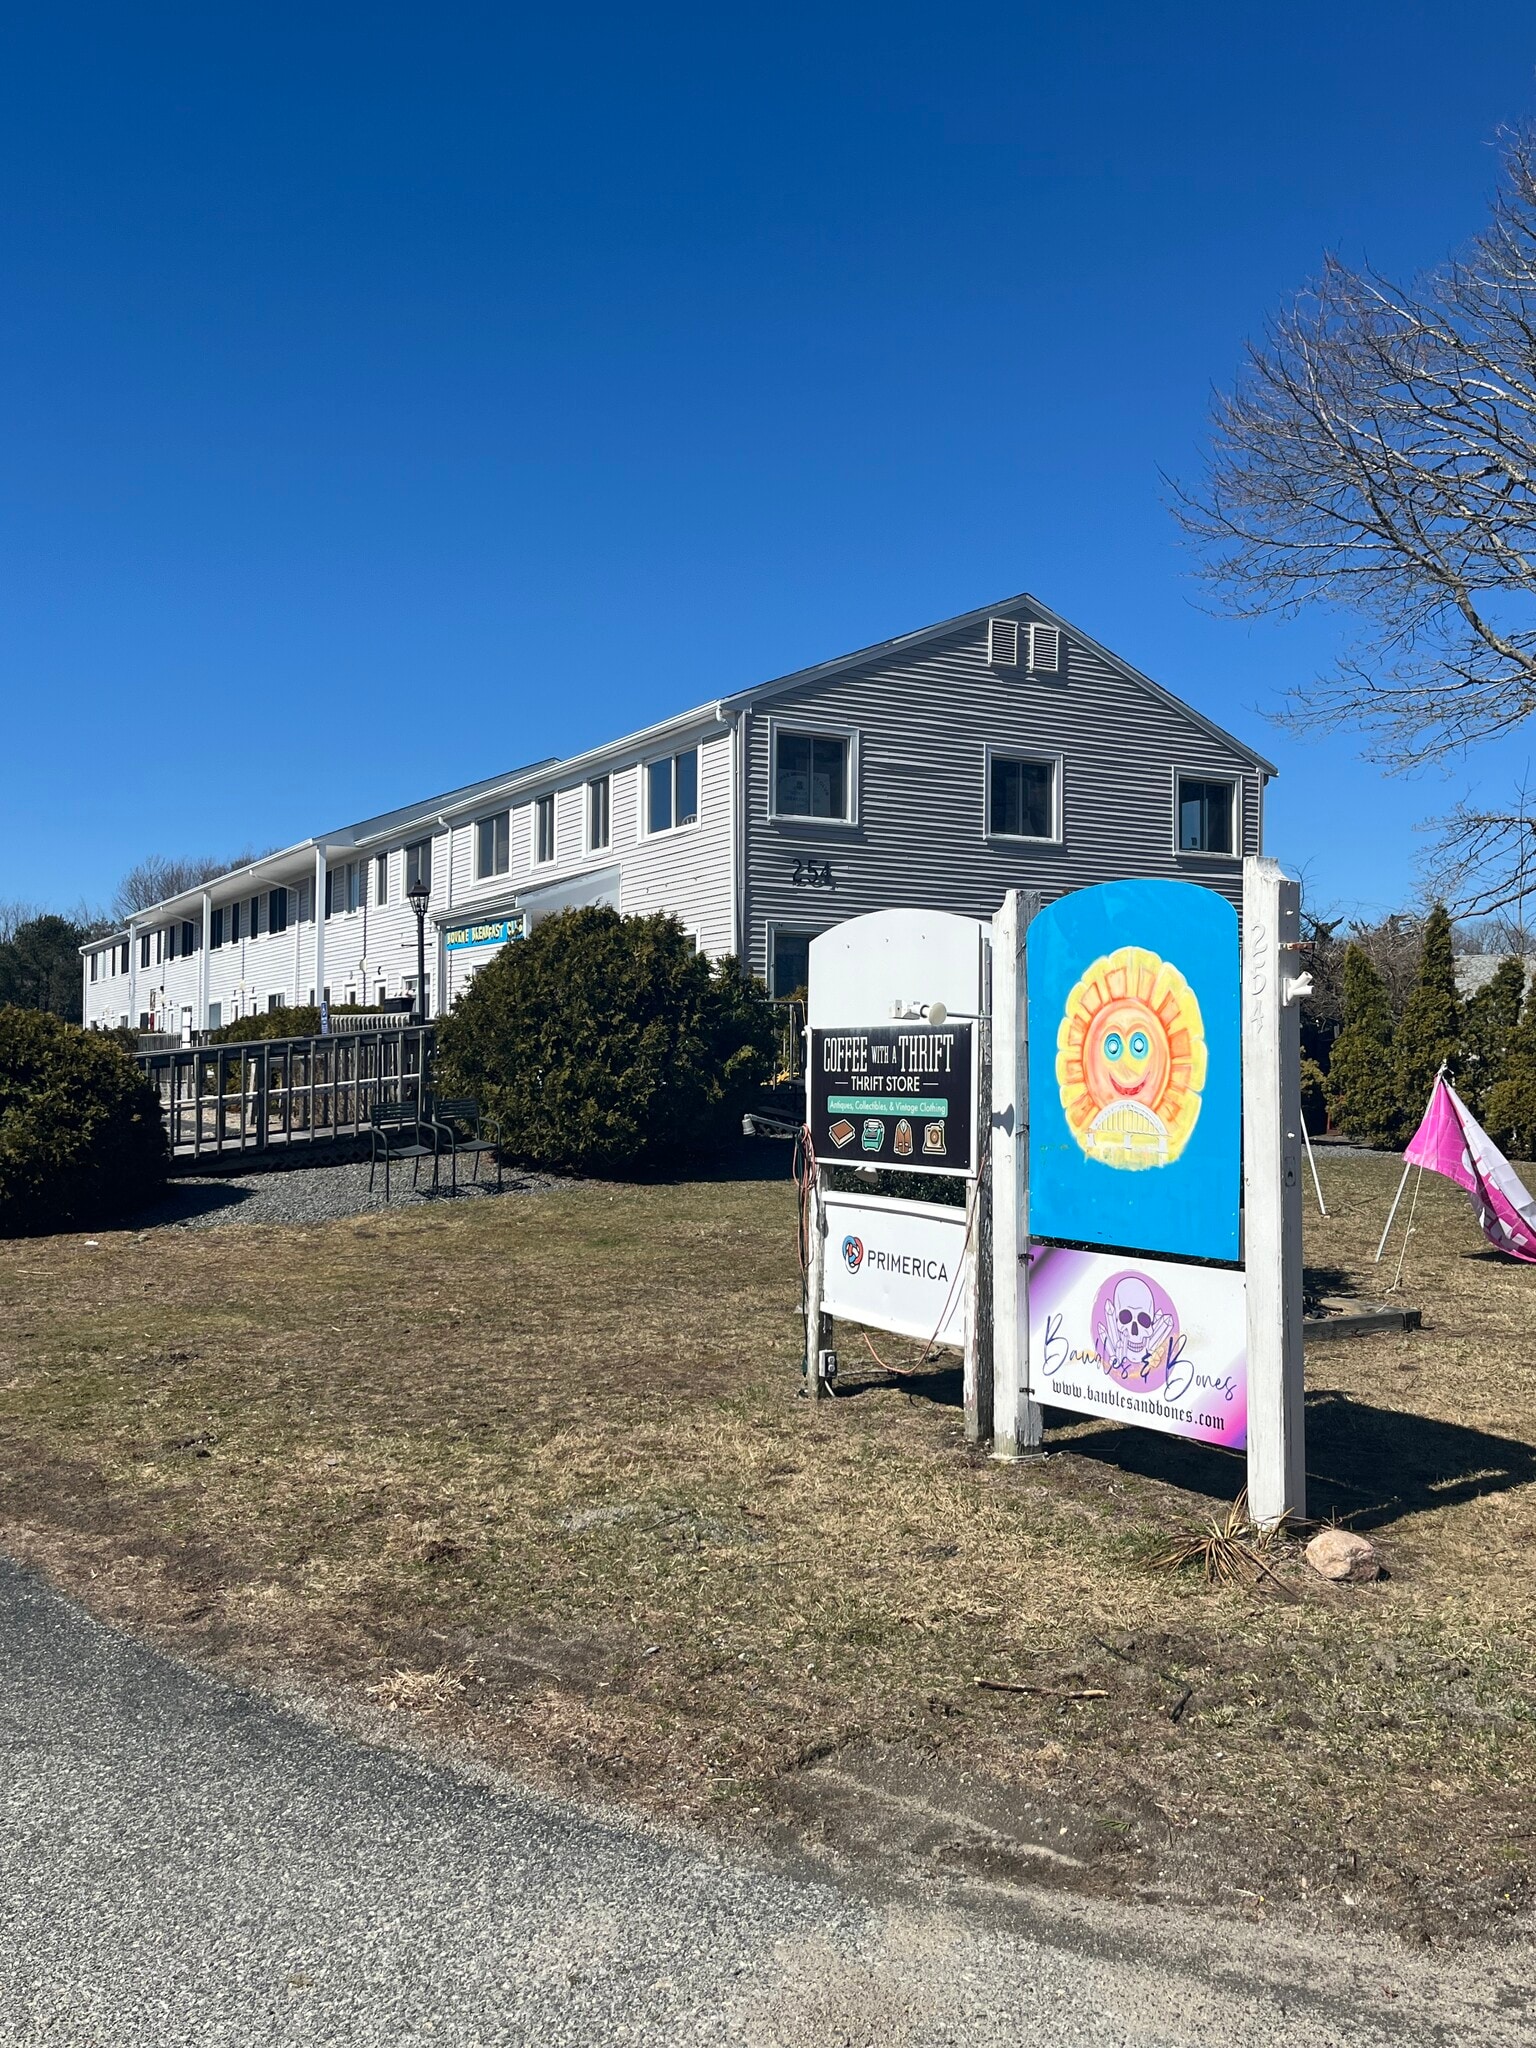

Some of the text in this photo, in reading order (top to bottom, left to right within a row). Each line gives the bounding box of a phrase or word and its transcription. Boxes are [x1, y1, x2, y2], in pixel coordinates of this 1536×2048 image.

[823, 1034, 954, 1073] COFFEE WITH A THRIFT
[851, 1076, 920, 1092] THRIFT STORE
[830, 1100, 946, 1115] Antiques, Collectibles, & Vintage Clothing
[867, 1250, 948, 1282] PRIMERICA
[1140, 1350, 1152, 1384] &
[1163, 1334, 1237, 1402] Bones
[1052, 1379, 1225, 1431] www.baublesandbones.com
